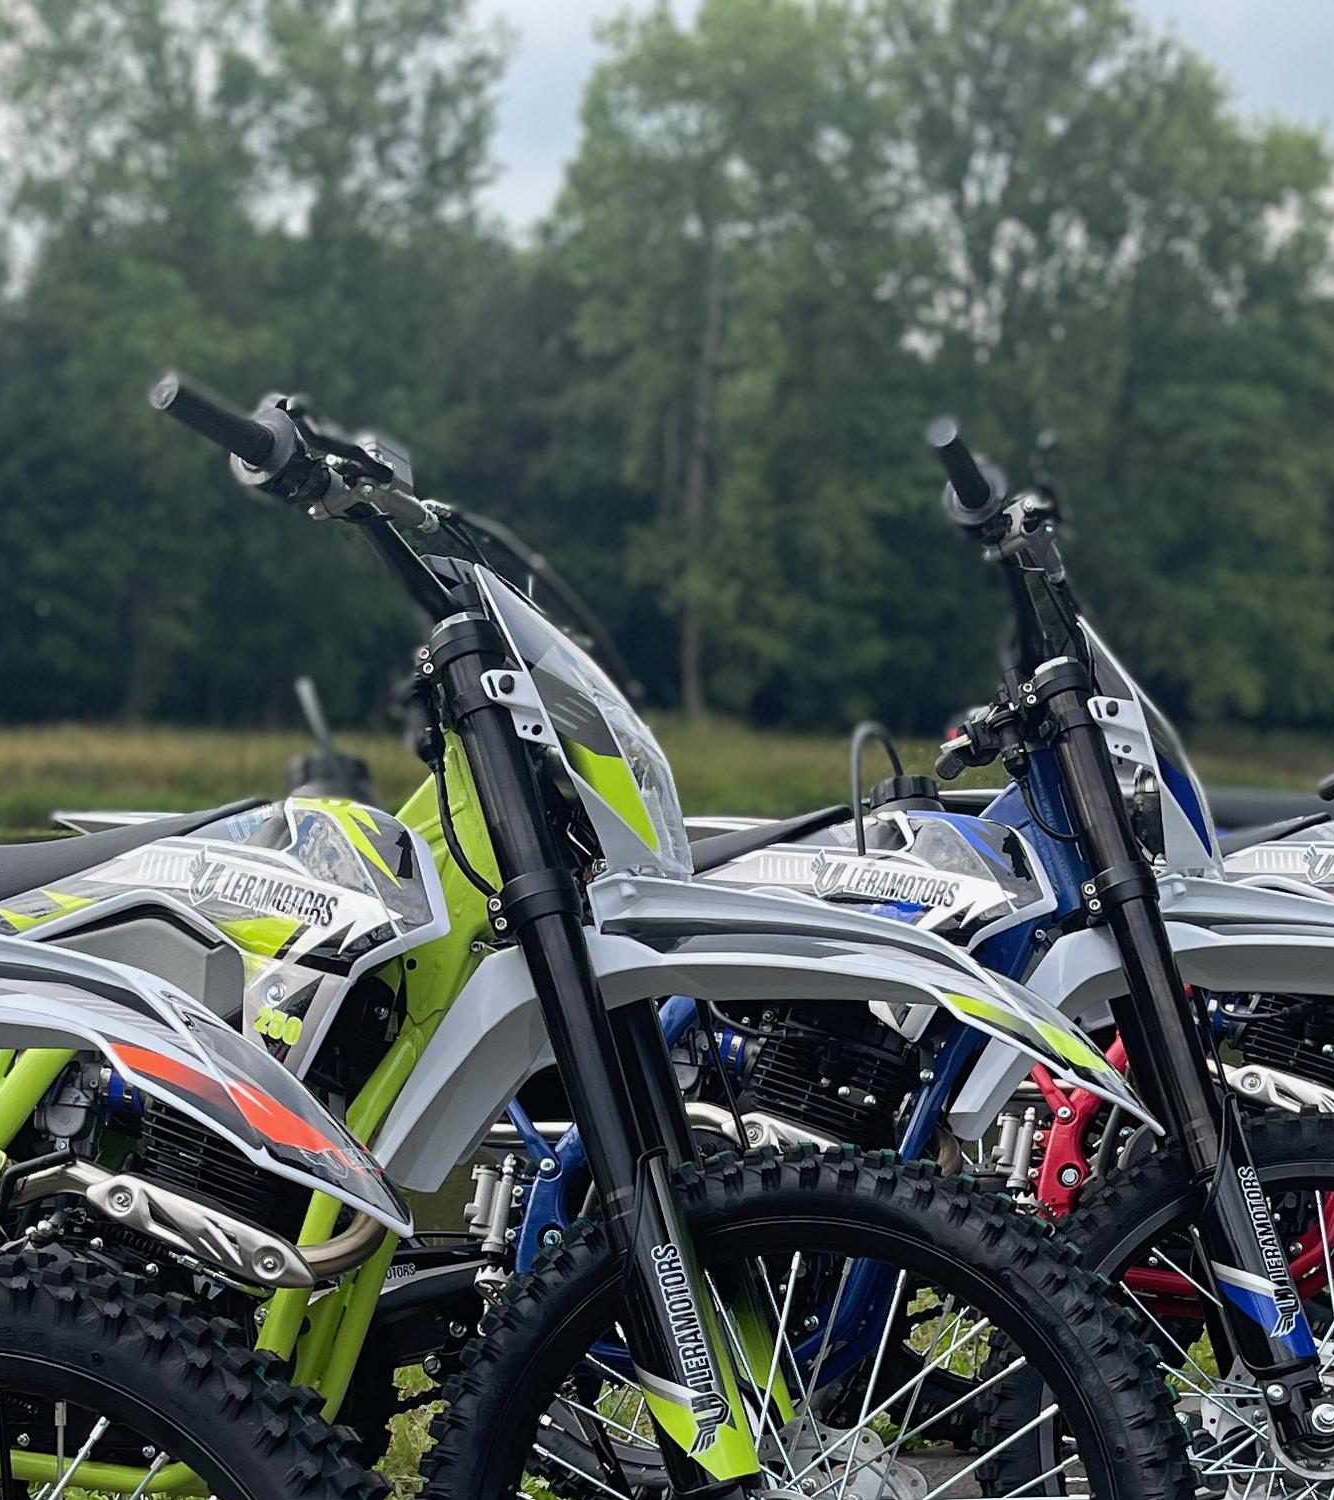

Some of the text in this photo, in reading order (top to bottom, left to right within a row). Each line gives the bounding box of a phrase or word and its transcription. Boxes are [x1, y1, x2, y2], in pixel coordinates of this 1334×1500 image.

[218, 870, 339, 928] LERAMOTORS
[844, 866, 961, 908] LERAMOTORS
[253, 1005, 303, 1046] 250
[1237, 1166, 1290, 1283] LERAMOTORS
[650, 1242, 715, 1389] LERAMOTORS
